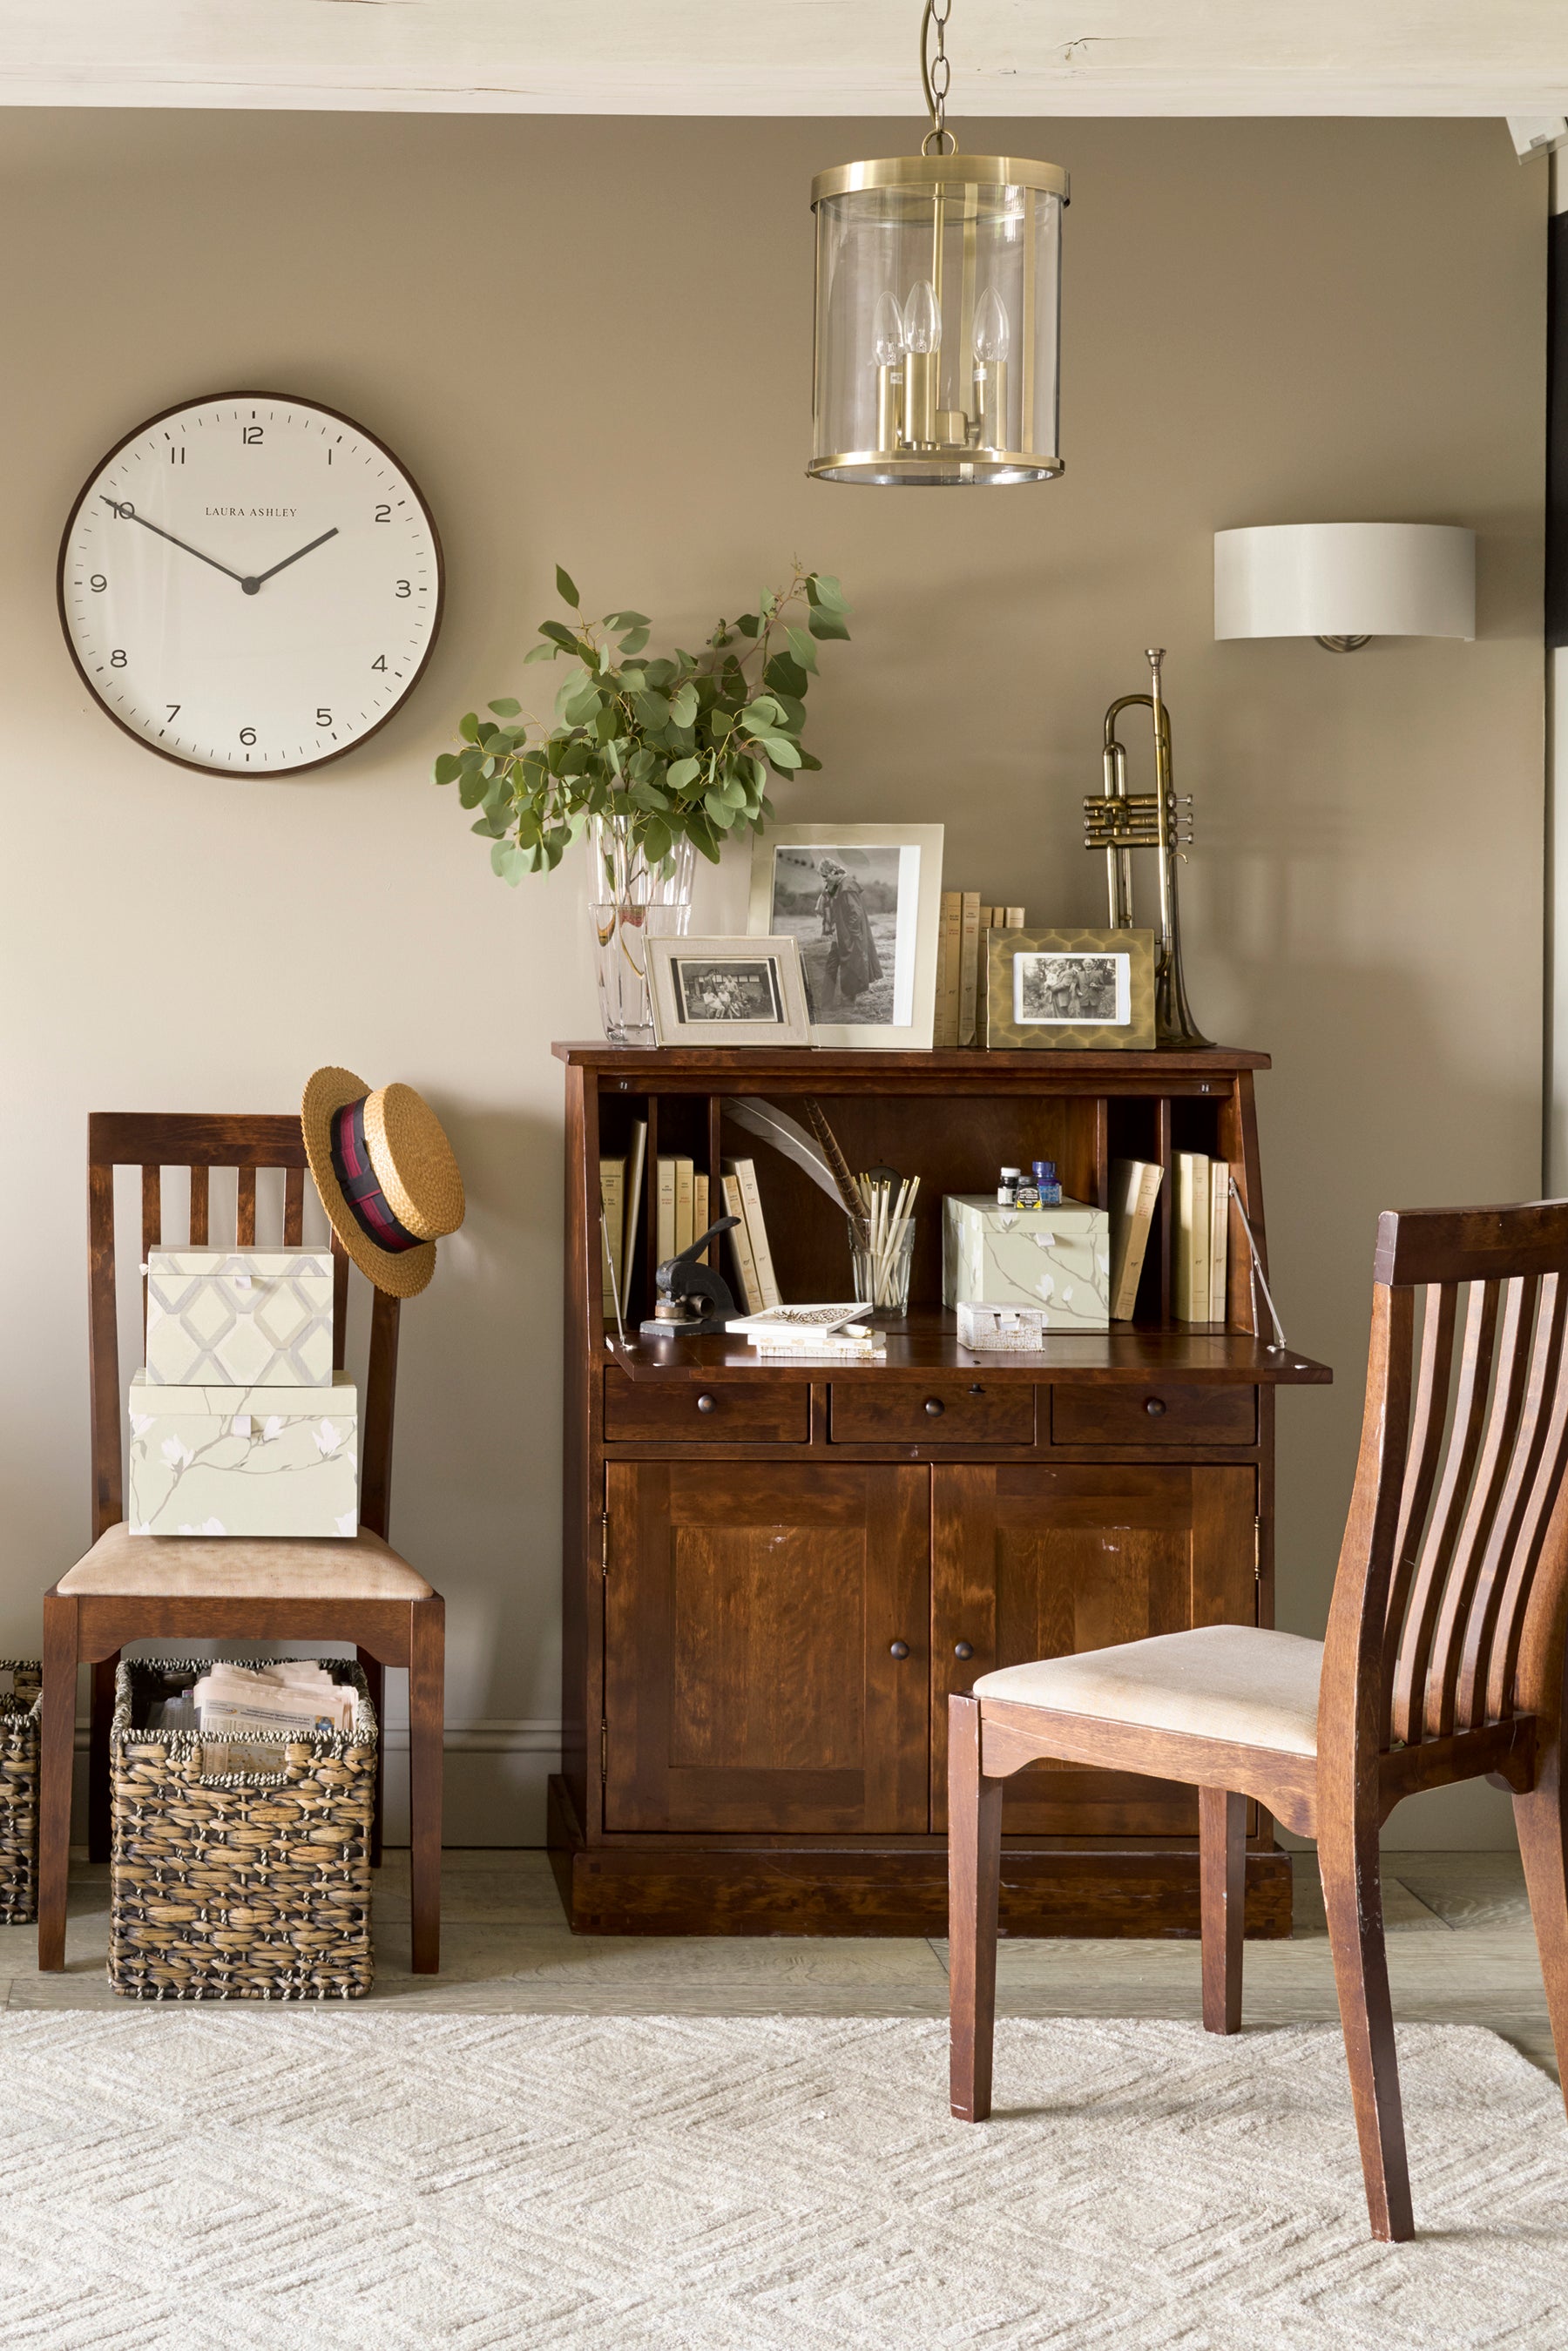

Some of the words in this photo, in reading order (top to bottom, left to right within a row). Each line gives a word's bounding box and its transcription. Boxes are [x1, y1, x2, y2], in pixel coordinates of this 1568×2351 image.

[243, 427, 263, 444] 12
[172, 447, 185, 464] 11
[112, 502, 135, 520] 10
[206, 507, 245, 517] LAURA
[249, 508, 297, 517] ASHLEY
[375, 504, 391, 523] 2
[91, 574, 107, 592] 9
[395, 580, 411, 598] 3
[111, 650, 127, 668] 8
[371, 655, 388, 672] 4
[166, 705, 181, 722] 7
[316, 708, 332, 726] 5
[240, 727, 256, 746] 6
